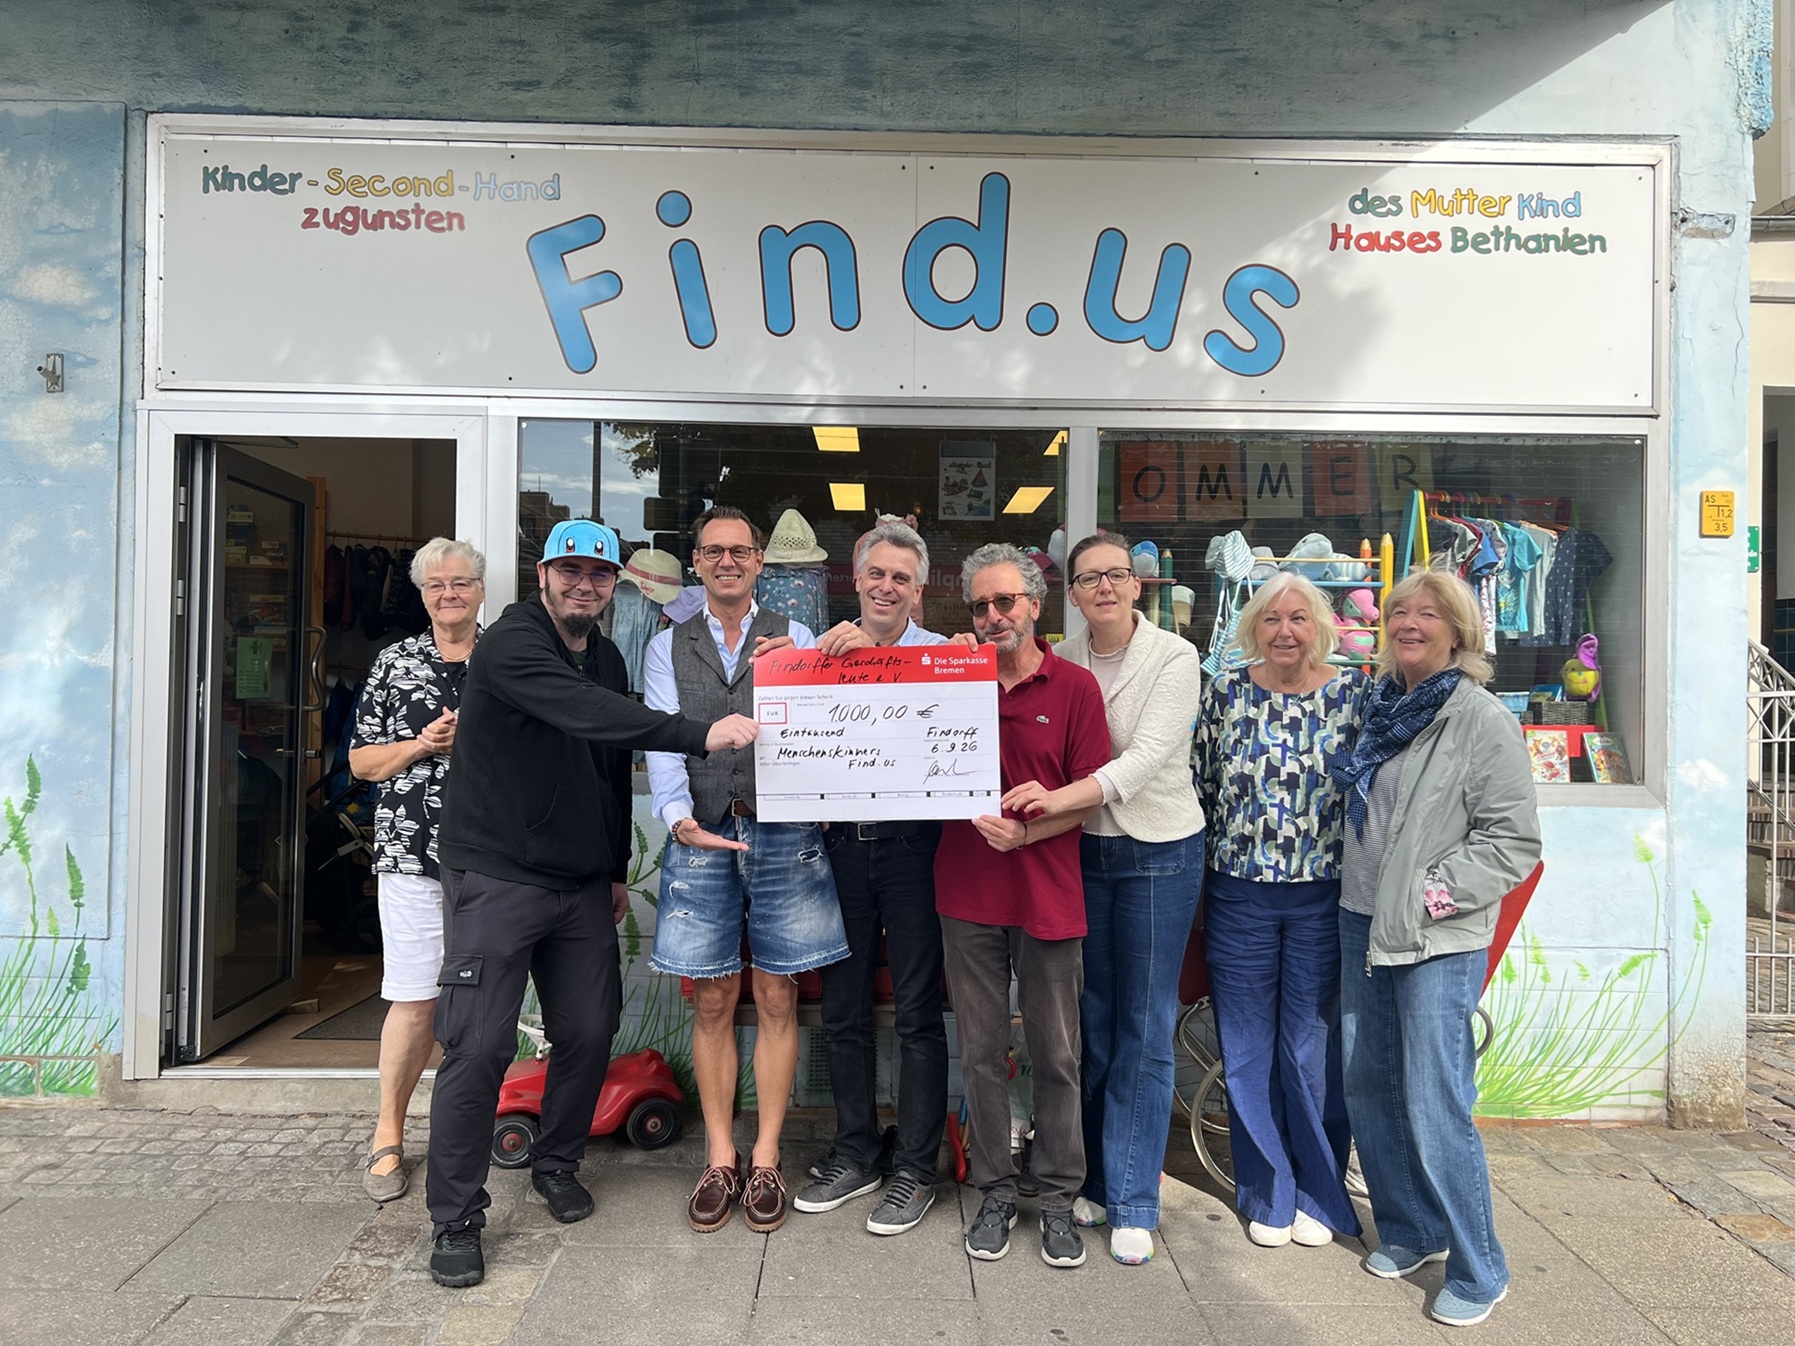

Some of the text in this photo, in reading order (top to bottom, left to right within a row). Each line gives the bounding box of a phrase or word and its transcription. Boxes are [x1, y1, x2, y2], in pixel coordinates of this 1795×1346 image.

[302, 203, 466, 236] zugunsten
[1348, 186, 1582, 221] des Mutter Kind
[1328, 223, 1608, 256] Hauses Bethanien
[525, 171, 1301, 378] Find.us
[1132, 453, 1418, 502] OMMER
[1705, 495, 1716, 503] AS
[934, 657, 947, 665] Die
[949, 656, 989, 666] Sparkasse
[926, 726, 979, 740] Findorff
